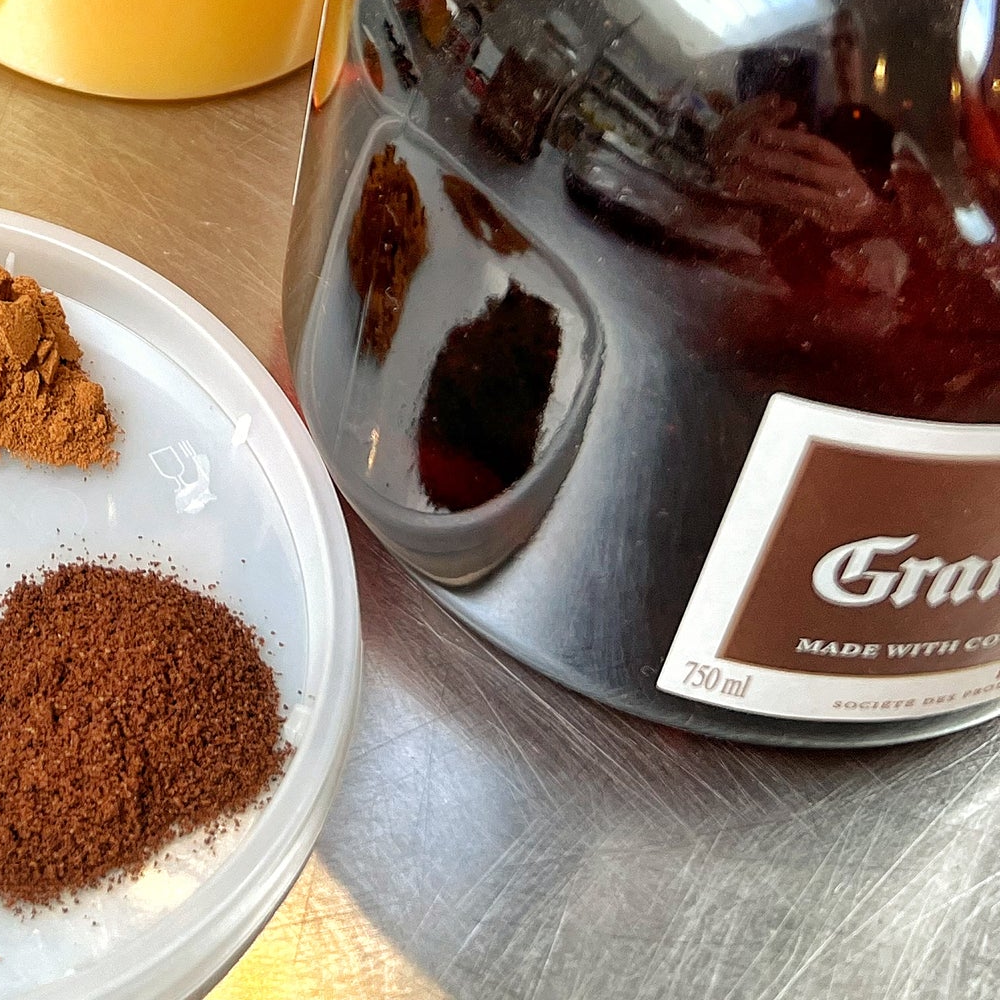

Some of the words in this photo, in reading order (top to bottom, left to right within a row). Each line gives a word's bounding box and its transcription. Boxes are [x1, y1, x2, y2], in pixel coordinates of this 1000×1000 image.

[795, 637, 881, 659] MADE
[887, 639, 960, 659] WITH
[683, 660, 721, 690] 750
[720, 675, 752, 698] ml
